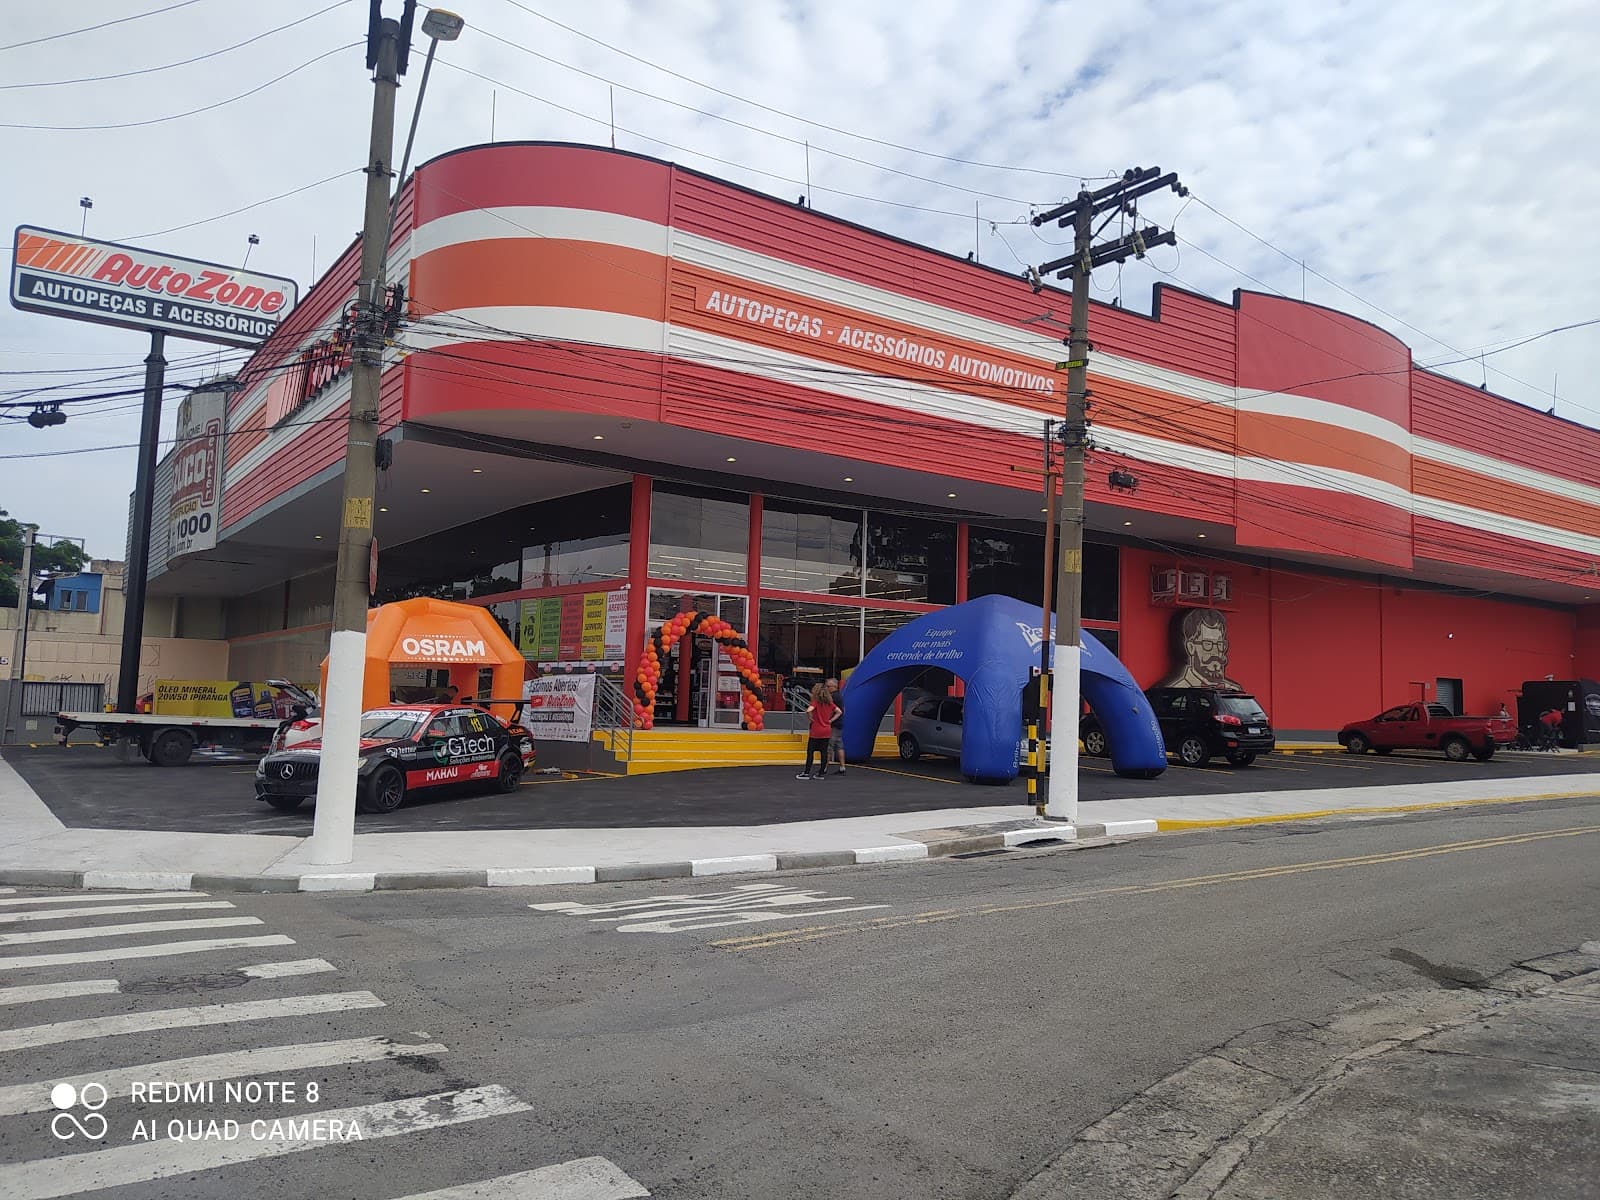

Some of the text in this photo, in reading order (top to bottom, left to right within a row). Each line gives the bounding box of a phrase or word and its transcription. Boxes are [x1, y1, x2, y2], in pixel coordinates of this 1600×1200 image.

[92, 253, 285, 313] AutoZone
[32, 280, 276, 336] AUTOPEÇAS E ACESSÓRIOS
[705, 290, 823, 338] AUTOPEÇAS
[837, 325, 946, 369] ACESSÓRIOS
[948, 354, 1055, 396] AUTOMOTIVOS
[925, 628, 956, 638] Equipe
[402, 637, 486, 657] OSRAM
[912, 640, 952, 650] que mais
[887, 649, 963, 660] entende de brilho
[181, 686, 217, 694] MINERAL
[448, 734, 495, 756] GTech
[426, 767, 458, 781] MAHAU
